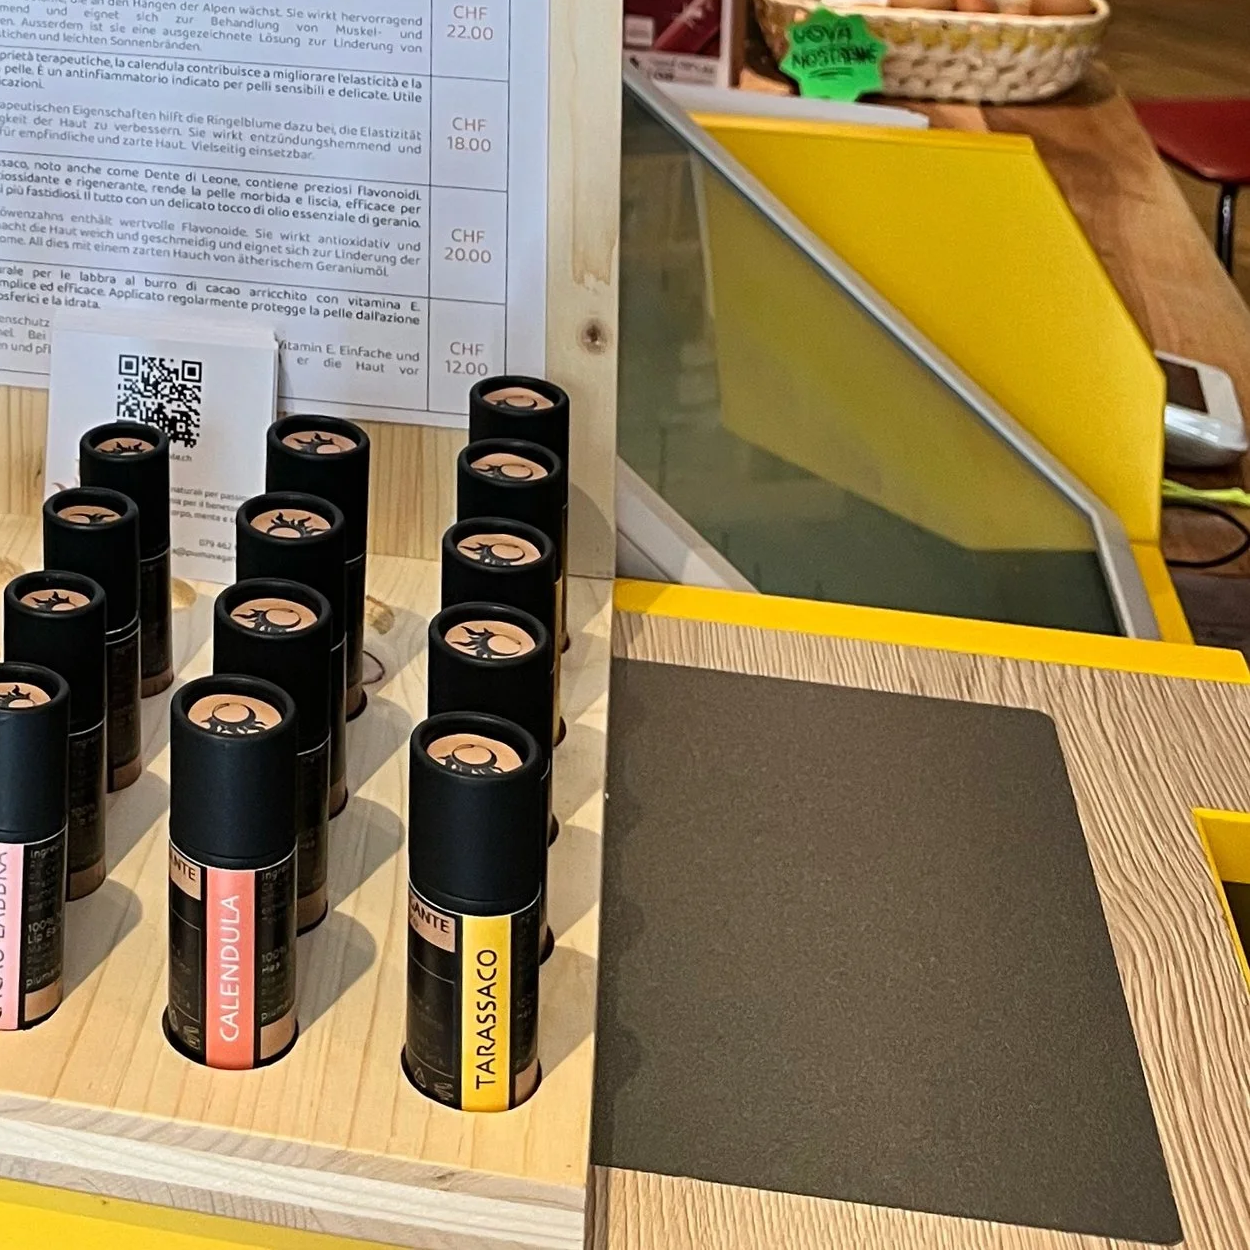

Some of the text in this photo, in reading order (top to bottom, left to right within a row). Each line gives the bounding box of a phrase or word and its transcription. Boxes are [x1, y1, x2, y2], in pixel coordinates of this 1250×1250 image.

[453, 5, 489, 20] CHF
[446, 24, 495, 41] 22.00
[47, 68, 62, 76] un
[65, 68, 169, 84] antinfiammatorio
[171, 74, 220, 87] indicato
[223, 80, 243, 90] per
[246, 81, 272, 92] pelli
[274, 84, 324, 95] sensibili
[392, 90, 422, 102] Utile
[452, 116, 488, 133] CHF
[446, 136, 492, 153] 18.00
[151, 184, 186, 194] rende
[191, 186, 201, 196] la
[206, 188, 235, 199] pelle
[240, 192, 290, 203] morbida
[345, 199, 395, 212] efficace
[400, 205, 421, 215] per
[451, 228, 486, 244] CHF
[444, 247, 492, 264] 20.00
[39, 281, 54, 290] ed
[108, 287, 165, 301] Applicato
[167, 294, 248, 309] regolarmente
[251, 302, 306, 316] protegge
[309, 305, 320, 315] la
[323, 308, 353, 319] pelle
[355, 310, 420, 325] dall'azione
[450, 341, 485, 356] CHF
[444, 360, 489, 377] 12.00
[411, 901, 450, 934] ANTE
[219, 895, 240, 1042] CALENDULA
[476, 950, 498, 1089] TARASSACO
